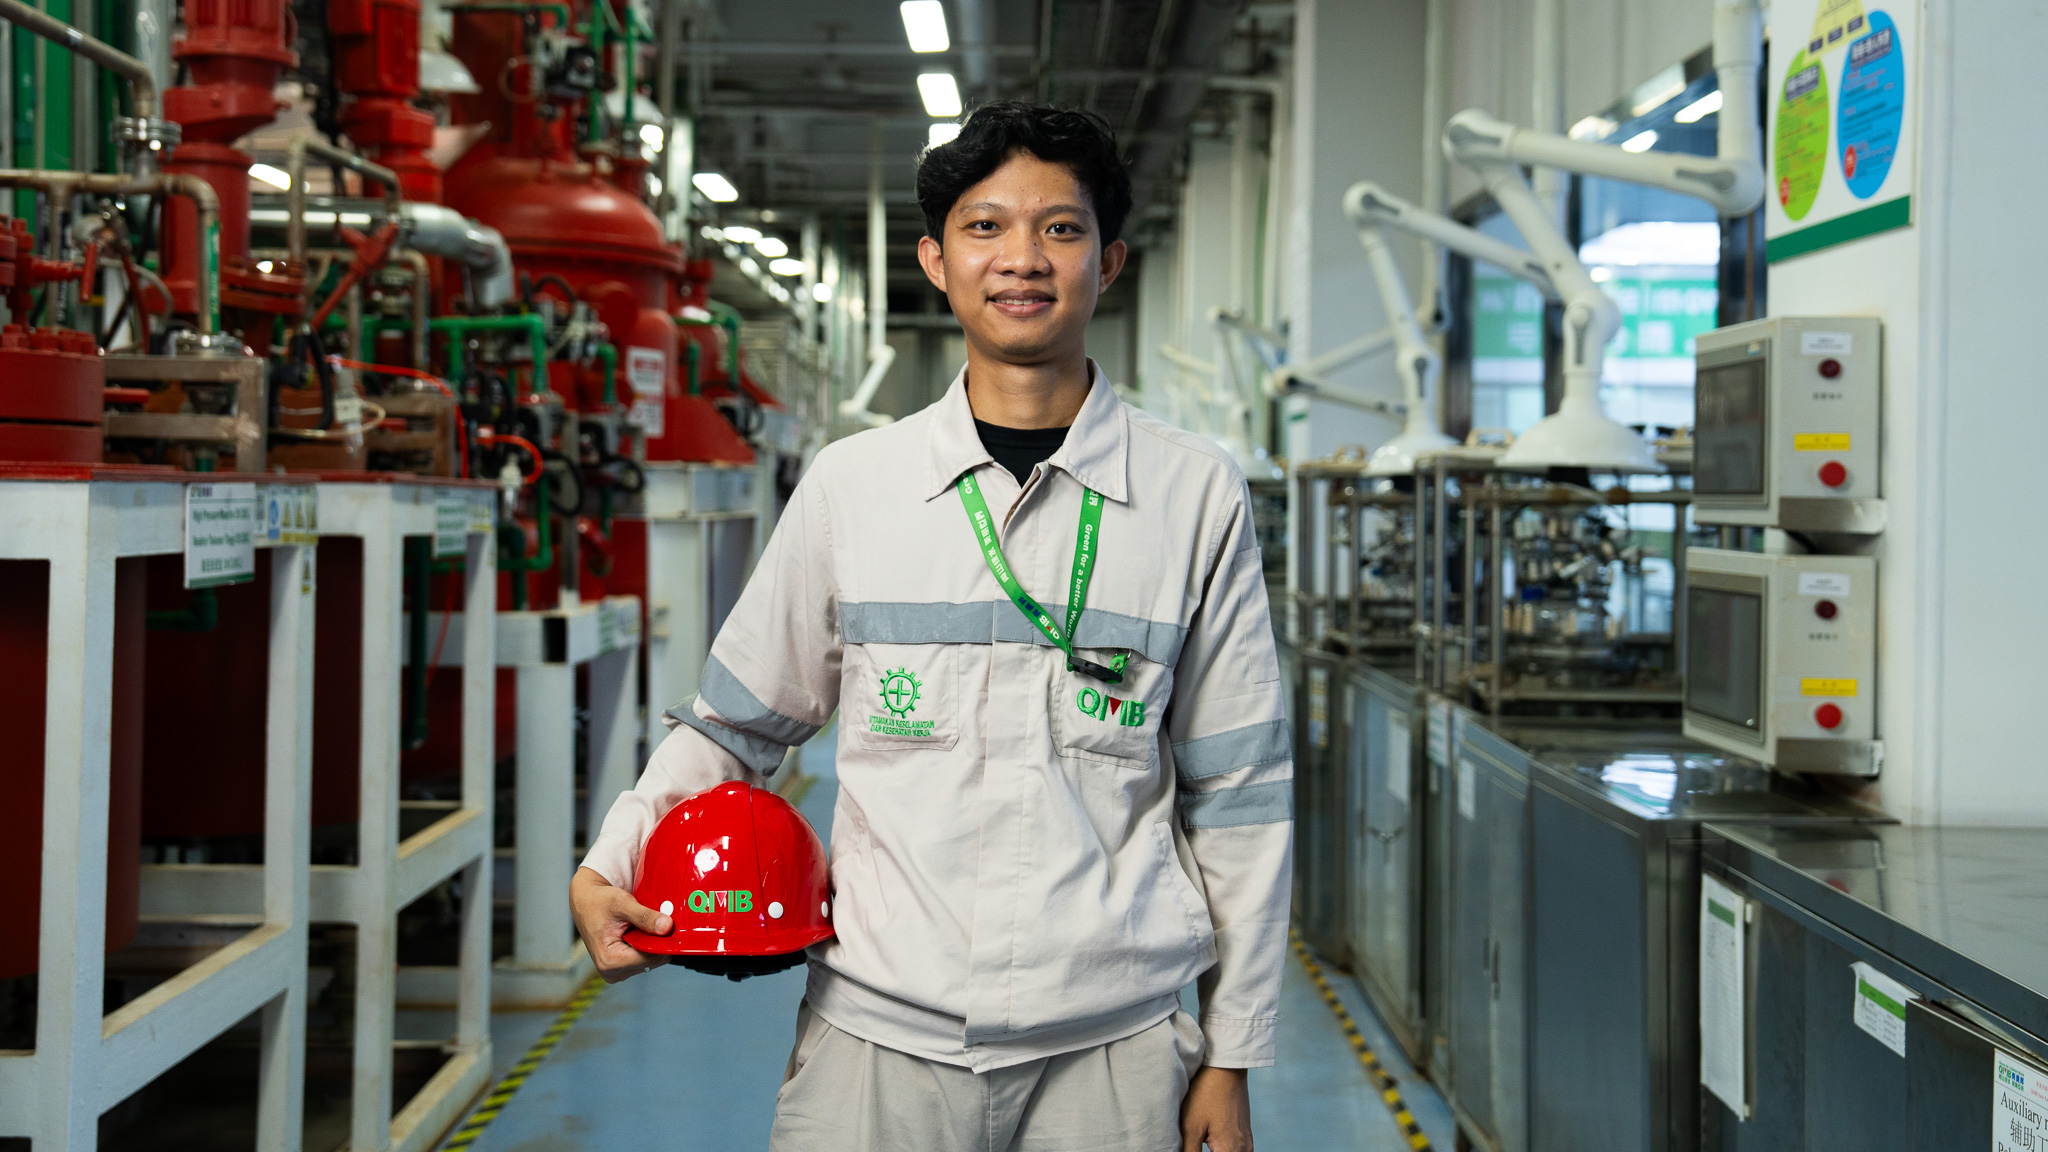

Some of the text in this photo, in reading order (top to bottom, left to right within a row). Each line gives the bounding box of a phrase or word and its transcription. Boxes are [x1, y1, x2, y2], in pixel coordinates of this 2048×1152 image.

[1082, 524, 1093, 551] Green
[1080, 553, 1089, 568] for
[1073, 578, 1083, 608] better
[1077, 687, 1145, 726] QMB
[869, 715, 935, 729] UTAMAKAN KESELAMATAN
[870, 724, 931, 737] DAN KESEHATAN KERJA
[688, 889, 753, 913] QMB
[2000, 1091, 2042, 1130] Auxiliary
